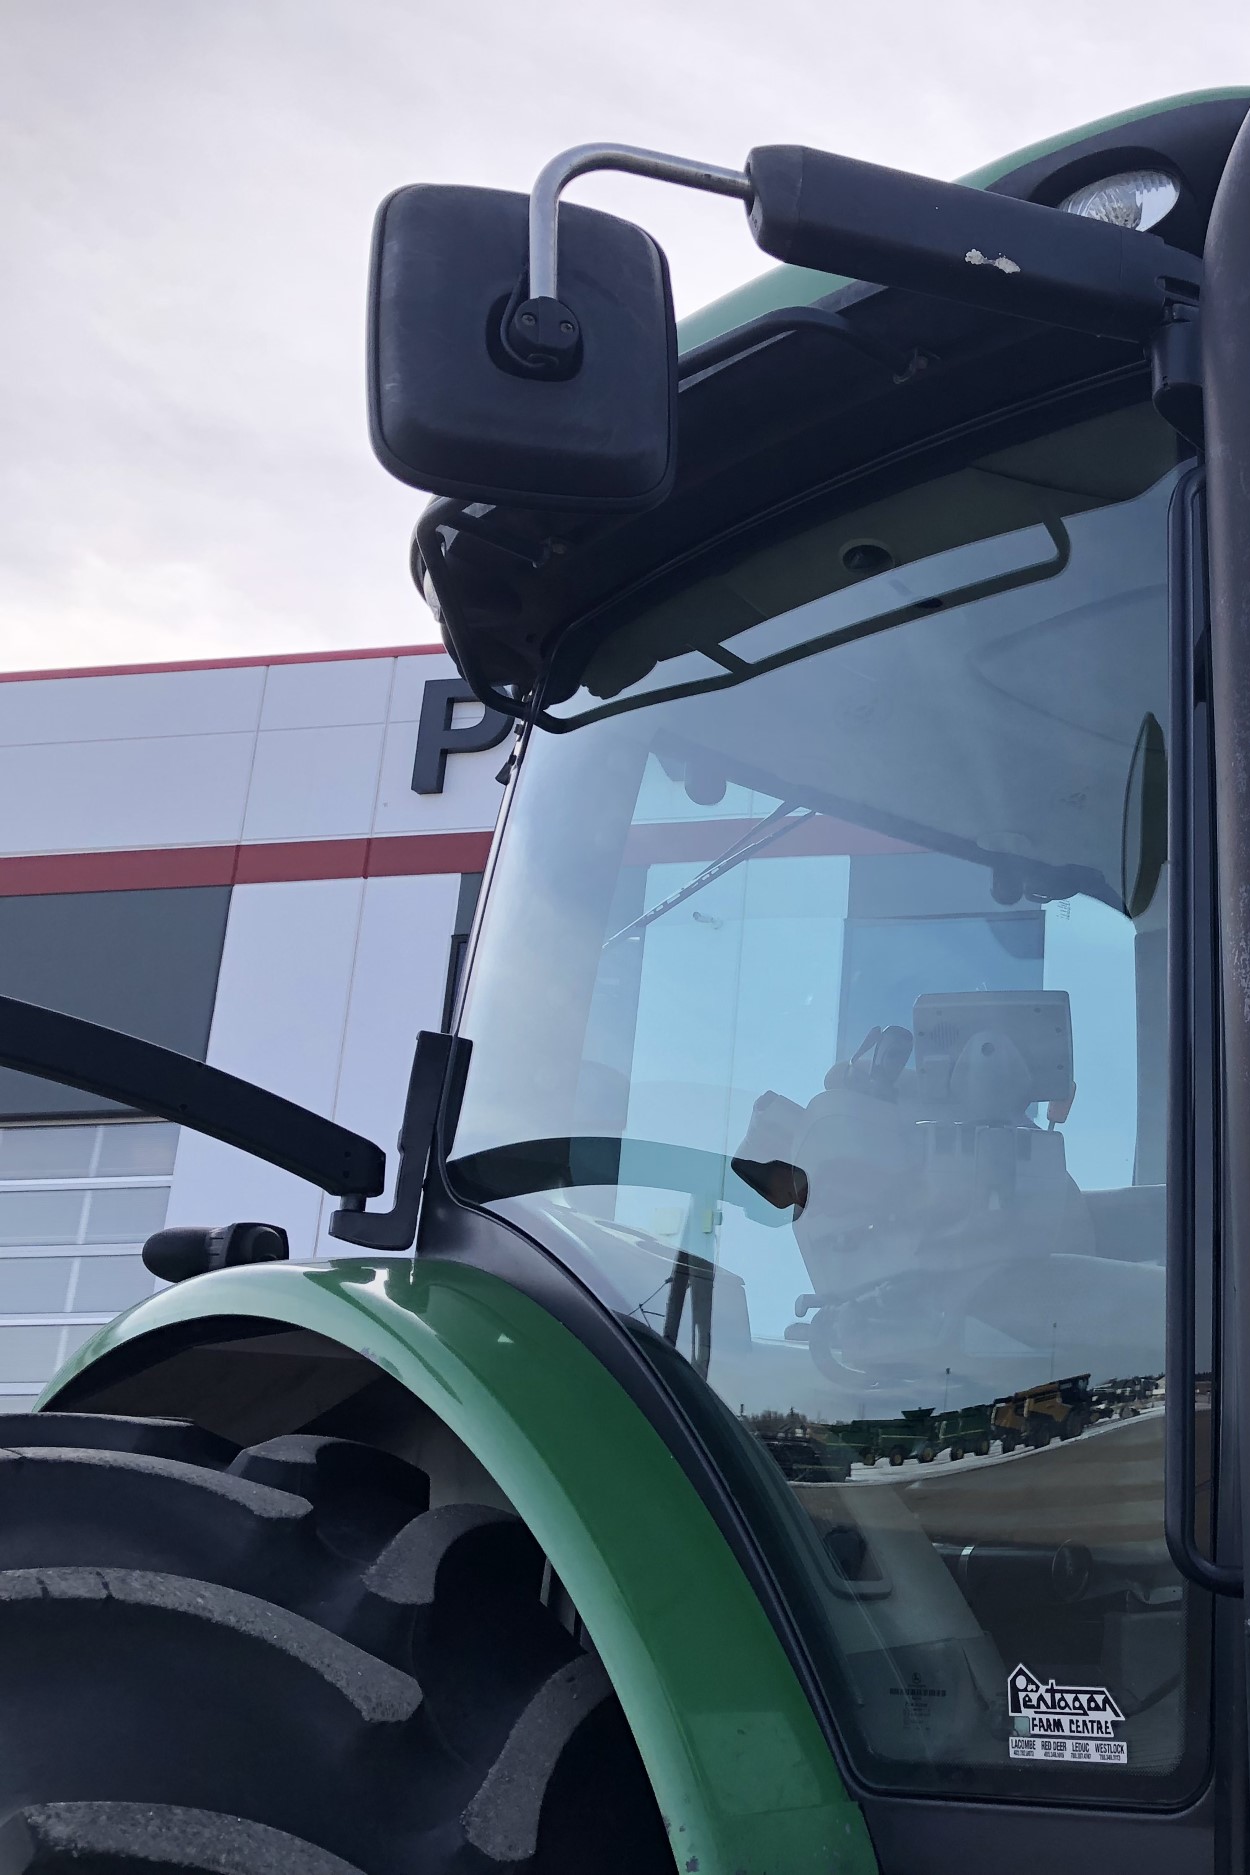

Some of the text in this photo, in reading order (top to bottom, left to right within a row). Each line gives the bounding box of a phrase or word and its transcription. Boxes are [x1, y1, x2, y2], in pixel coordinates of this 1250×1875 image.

[1031, 1717, 1112, 1735] FARM CENTRE
[1011, 1739, 1125, 1754] LACOMBE RED DEER LEDUC WESTLOCK
